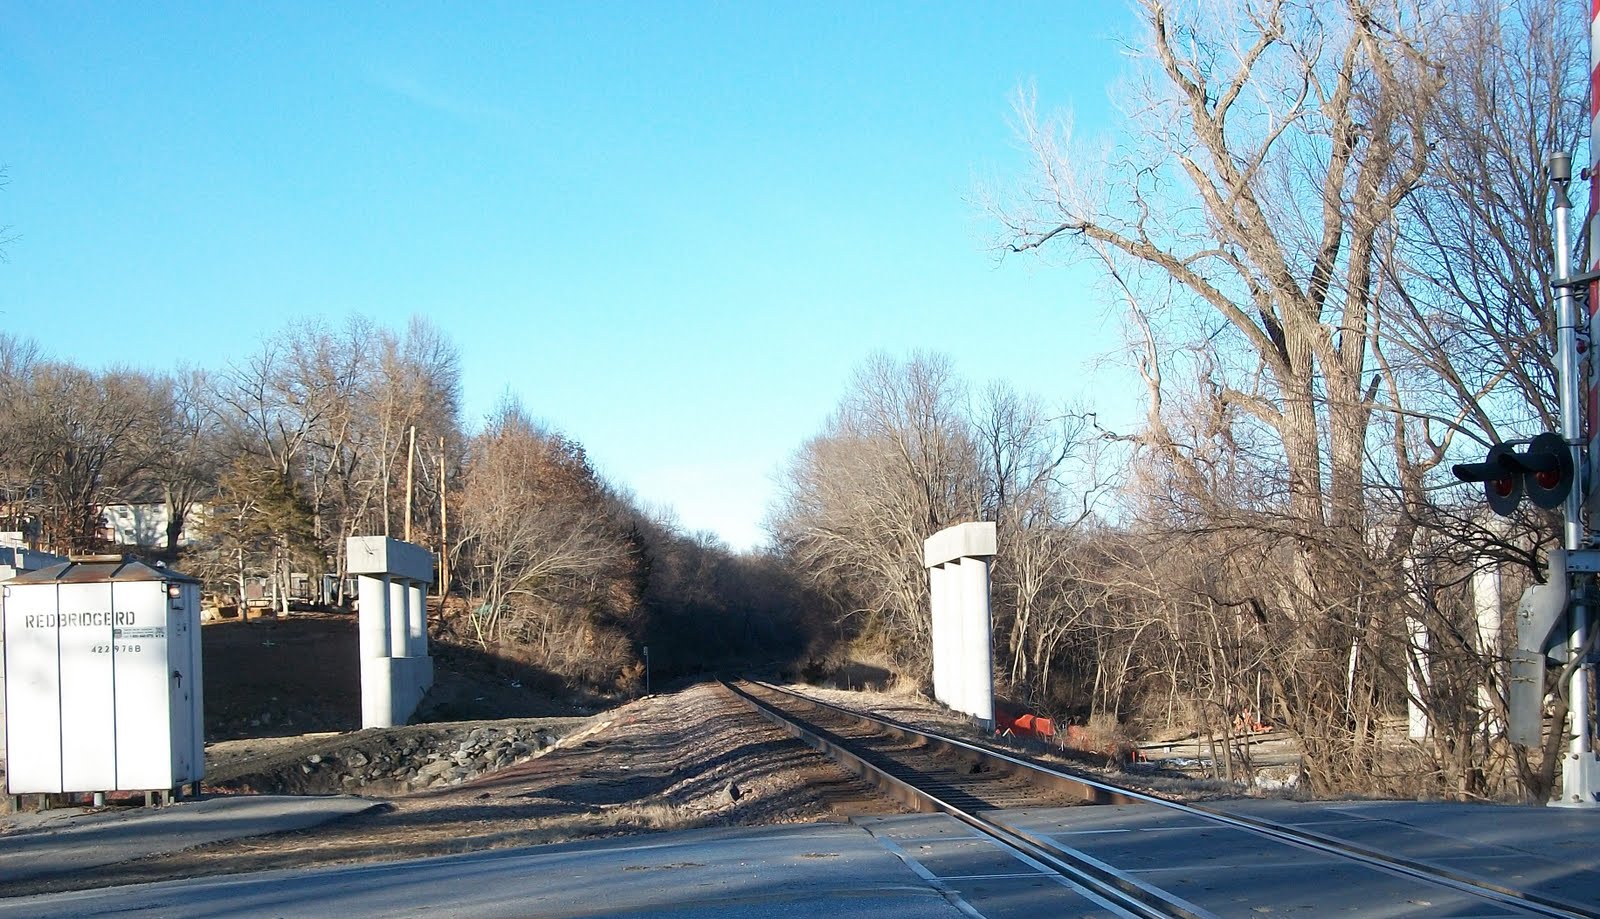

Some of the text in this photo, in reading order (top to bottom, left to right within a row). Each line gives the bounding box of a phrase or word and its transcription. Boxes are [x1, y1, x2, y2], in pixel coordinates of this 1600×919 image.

[25, 611, 136, 629] RED BRIDGE RD
